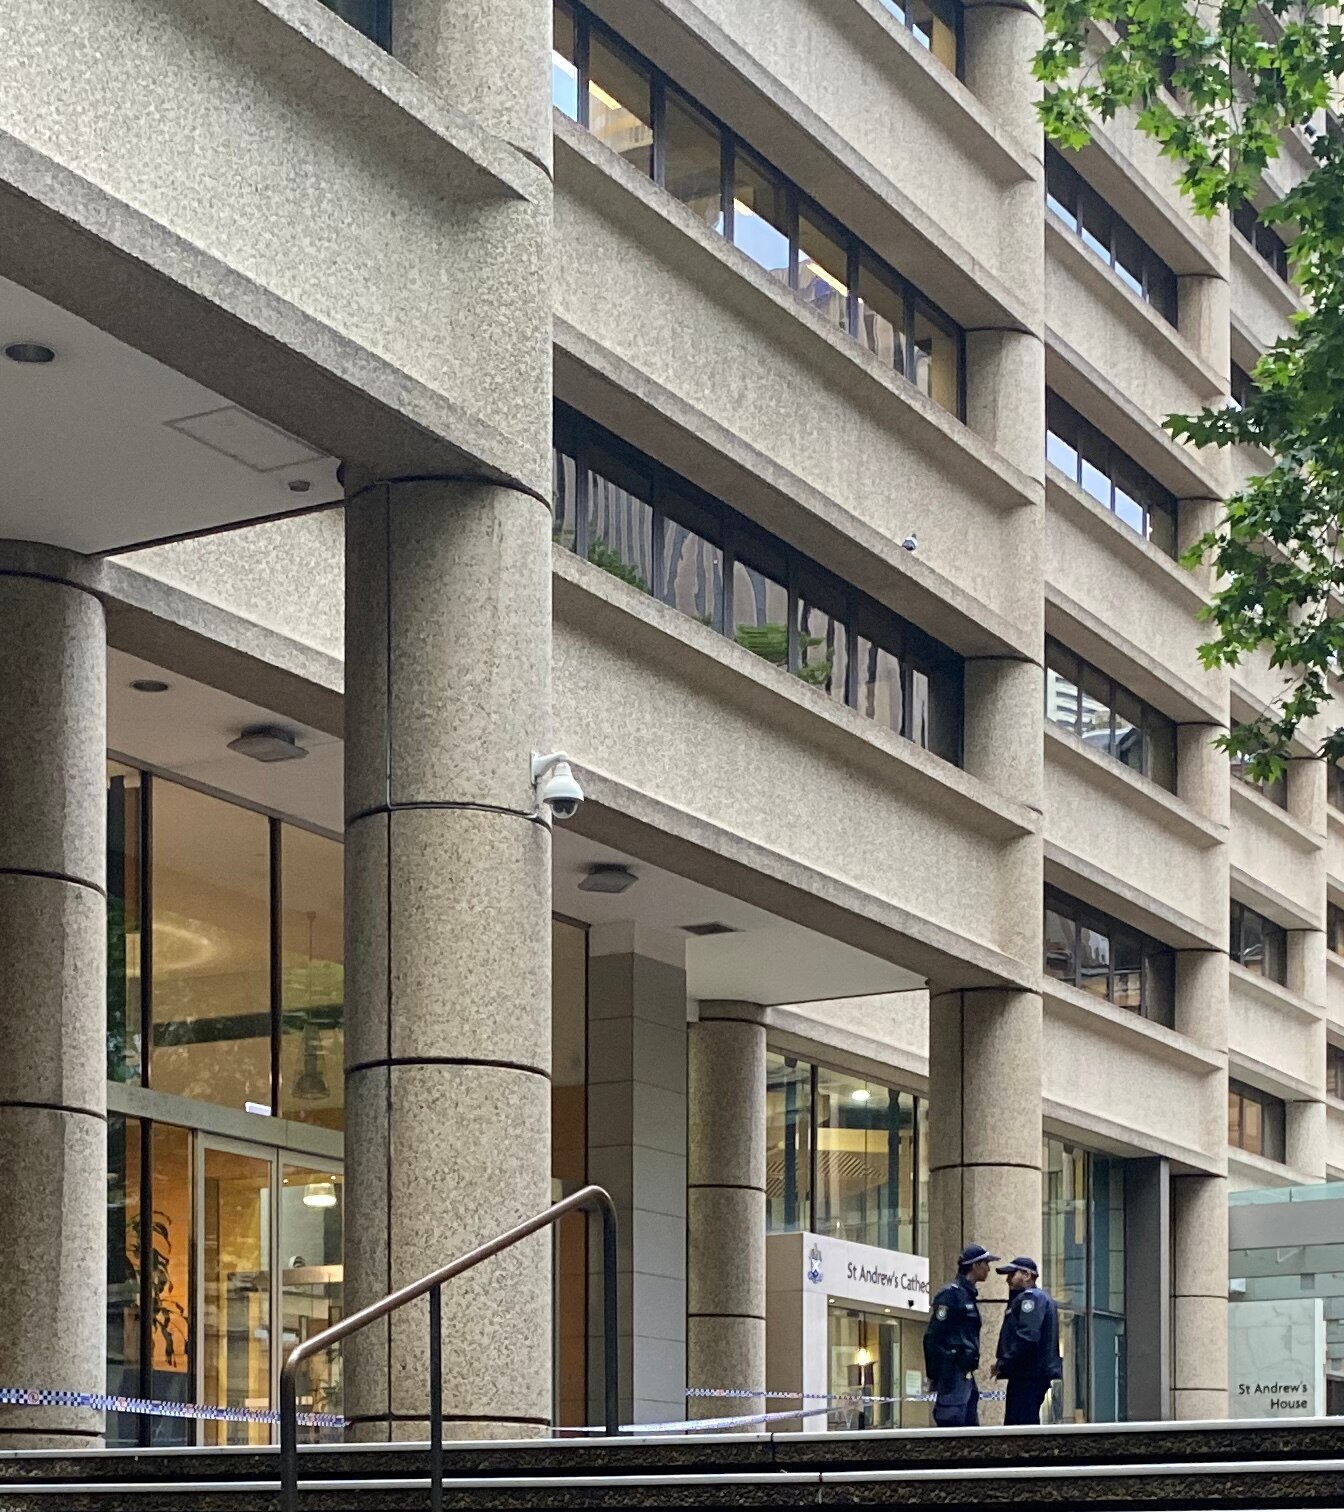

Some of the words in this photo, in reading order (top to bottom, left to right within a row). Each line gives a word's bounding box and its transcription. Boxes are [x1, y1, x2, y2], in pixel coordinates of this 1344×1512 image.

[847, 1262, 857, 1281] St
[859, 1264, 899, 1289] Andrew's
[1238, 1384, 1250, 1395] St
[1254, 1381, 1308, 1394] Andrew's
[1270, 1398, 1308, 1410] House
